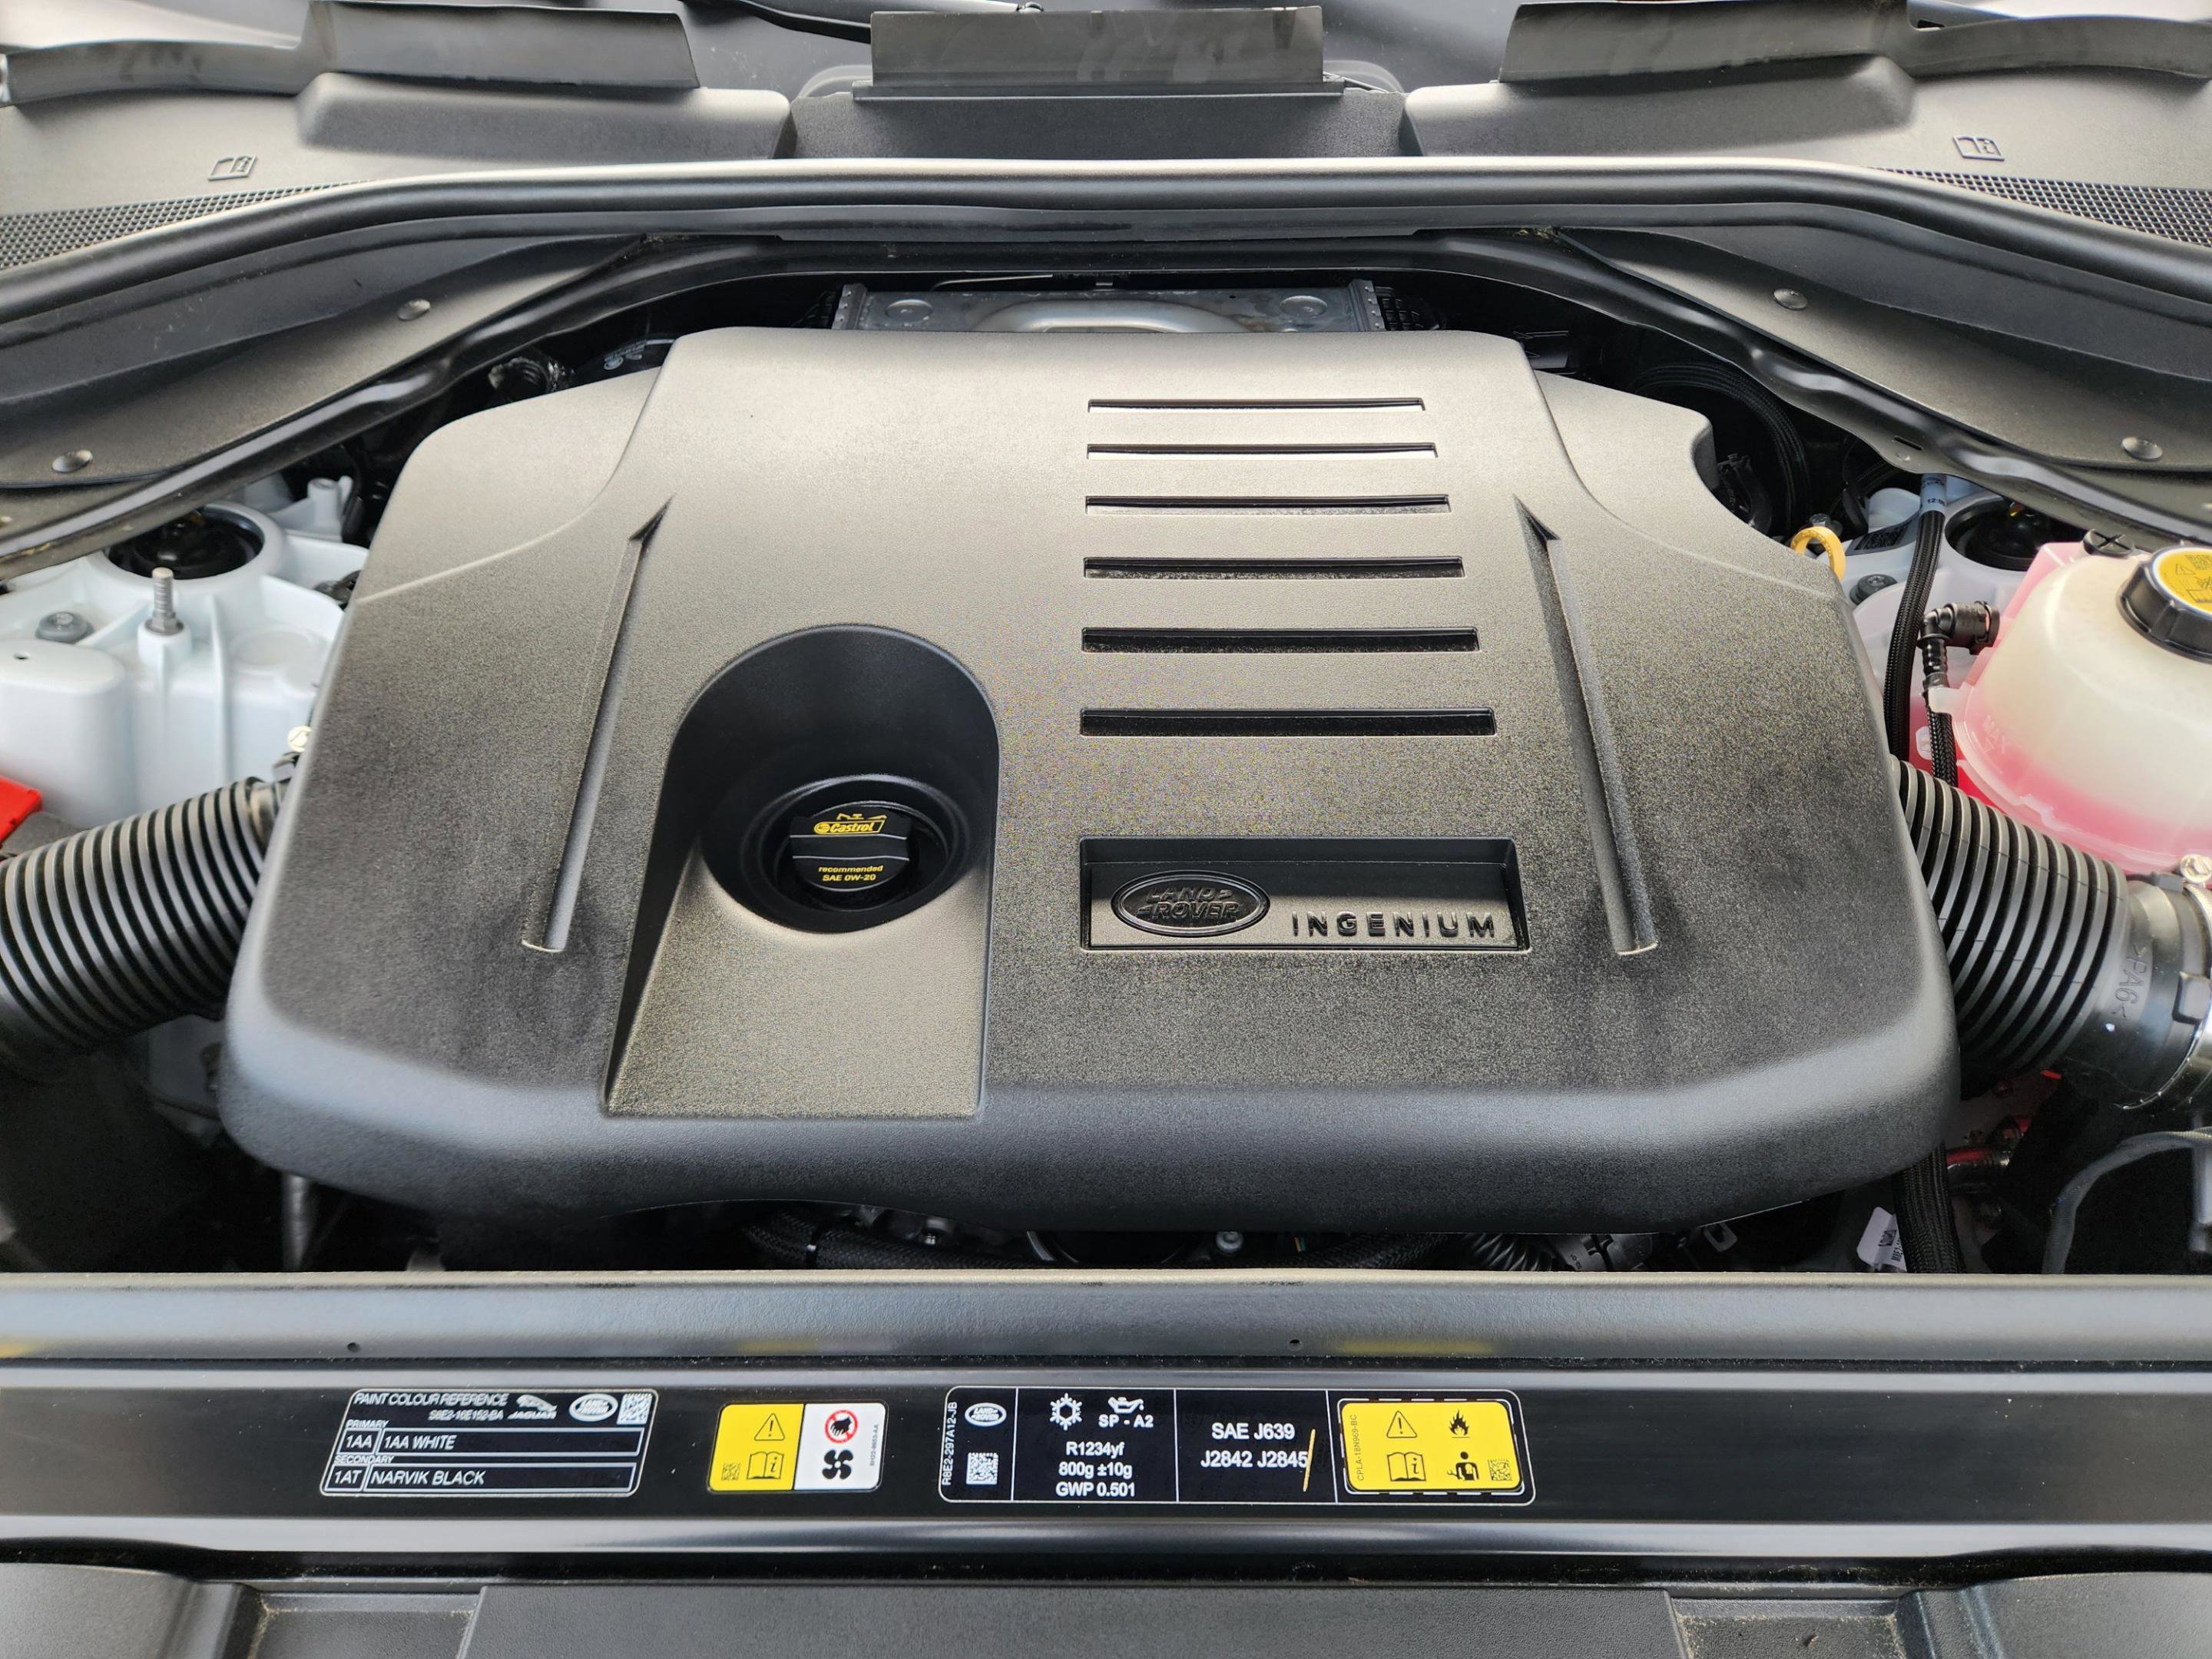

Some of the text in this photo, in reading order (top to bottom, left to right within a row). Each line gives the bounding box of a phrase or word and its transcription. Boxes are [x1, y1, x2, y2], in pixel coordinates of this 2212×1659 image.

[830, 822, 875, 833] Castrol
[844, 873, 876, 882] 0W-20
[1146, 886, 1217, 903] LAND
[1154, 901, 1240, 919] ROVER
[1291, 910, 1496, 938] INGENIUM
[353, 1392, 510, 1407] PAINT COLOUR REFERENCE
[346, 1419, 389, 1429] PRIMARY
[1098, 1414, 1120, 1428] SP
[1133, 1414, 1154, 1428] A2
[1211, 1422, 1296, 1440] SAE J639
[346, 1434, 373, 1449] 1AA
[383, 1434, 458, 1450] 1AA WHITE
[1065, 1441, 1125, 1459] R1234yf
[333, 1454, 395, 1465] SECONDARY
[1200, 1449, 1309, 1468] J2842 J2845
[334, 1469, 363, 1485] 1AT
[369, 1470, 486, 1486] NARVIK BLACK
[1058, 1461, 1133, 1480] 800g ±10g
[1055, 1482, 1135, 1498] GWP 0.501
